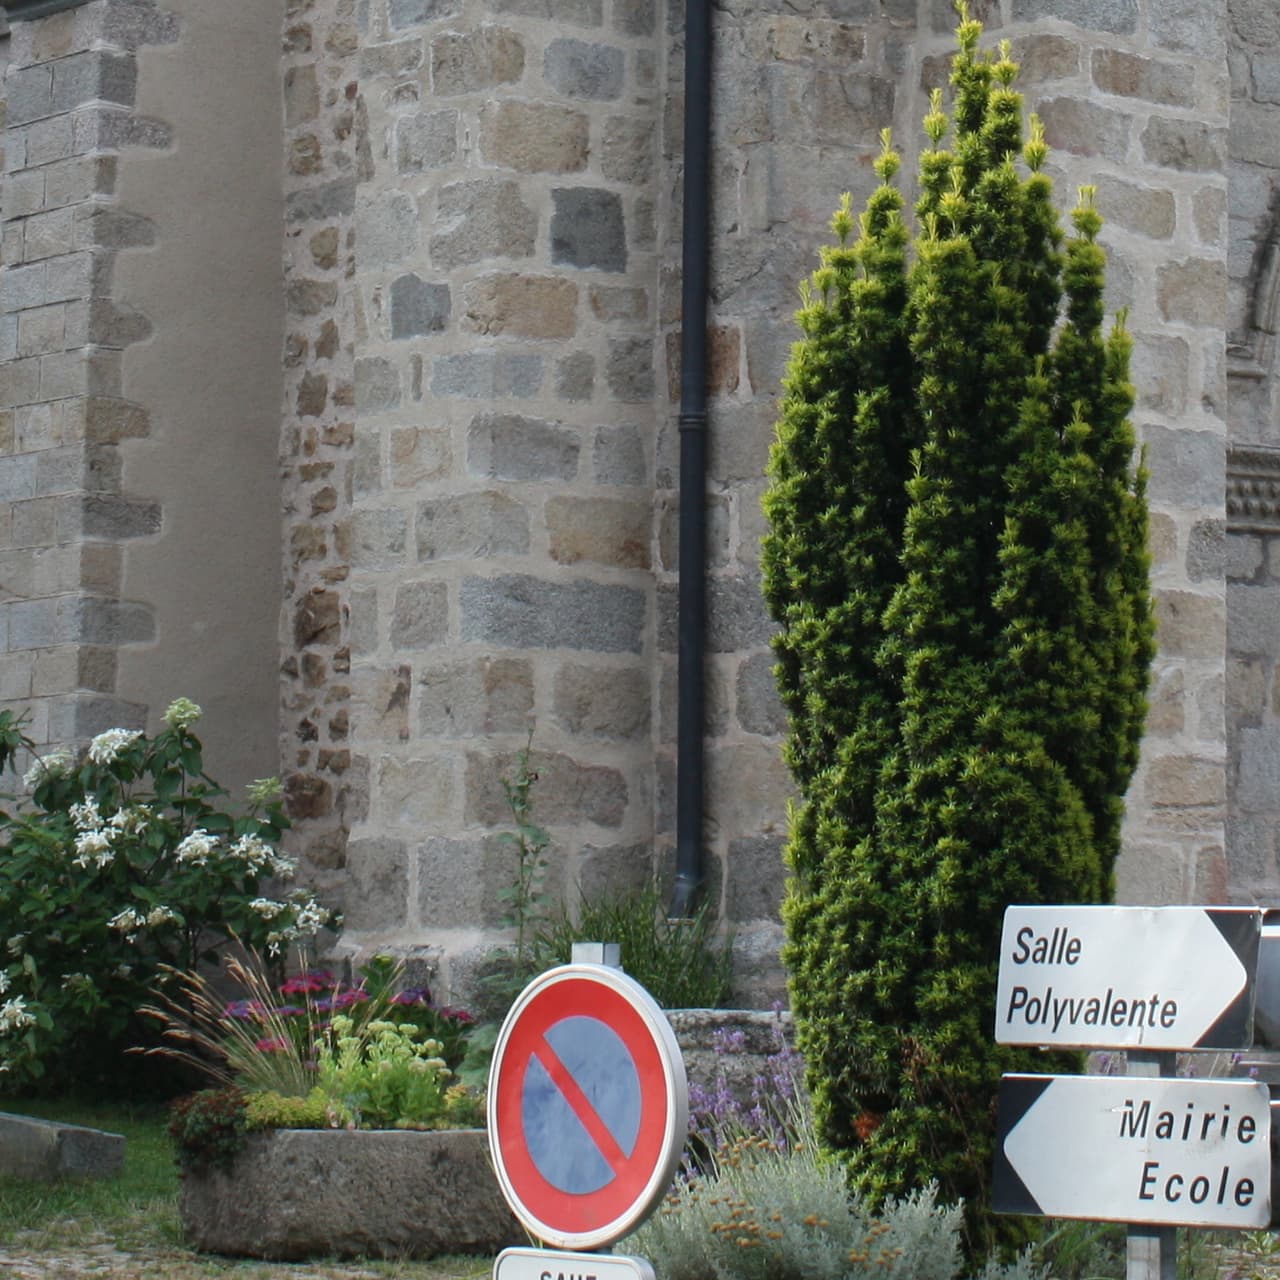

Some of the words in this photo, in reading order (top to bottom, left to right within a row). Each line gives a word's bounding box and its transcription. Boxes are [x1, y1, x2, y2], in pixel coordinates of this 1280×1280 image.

[1013, 927, 1081, 965] Salle
[1007, 987, 1176, 1033] Polyvalente
[1120, 1100, 1255, 1143] Mairie
[1139, 1162, 1254, 1207] Ecole
